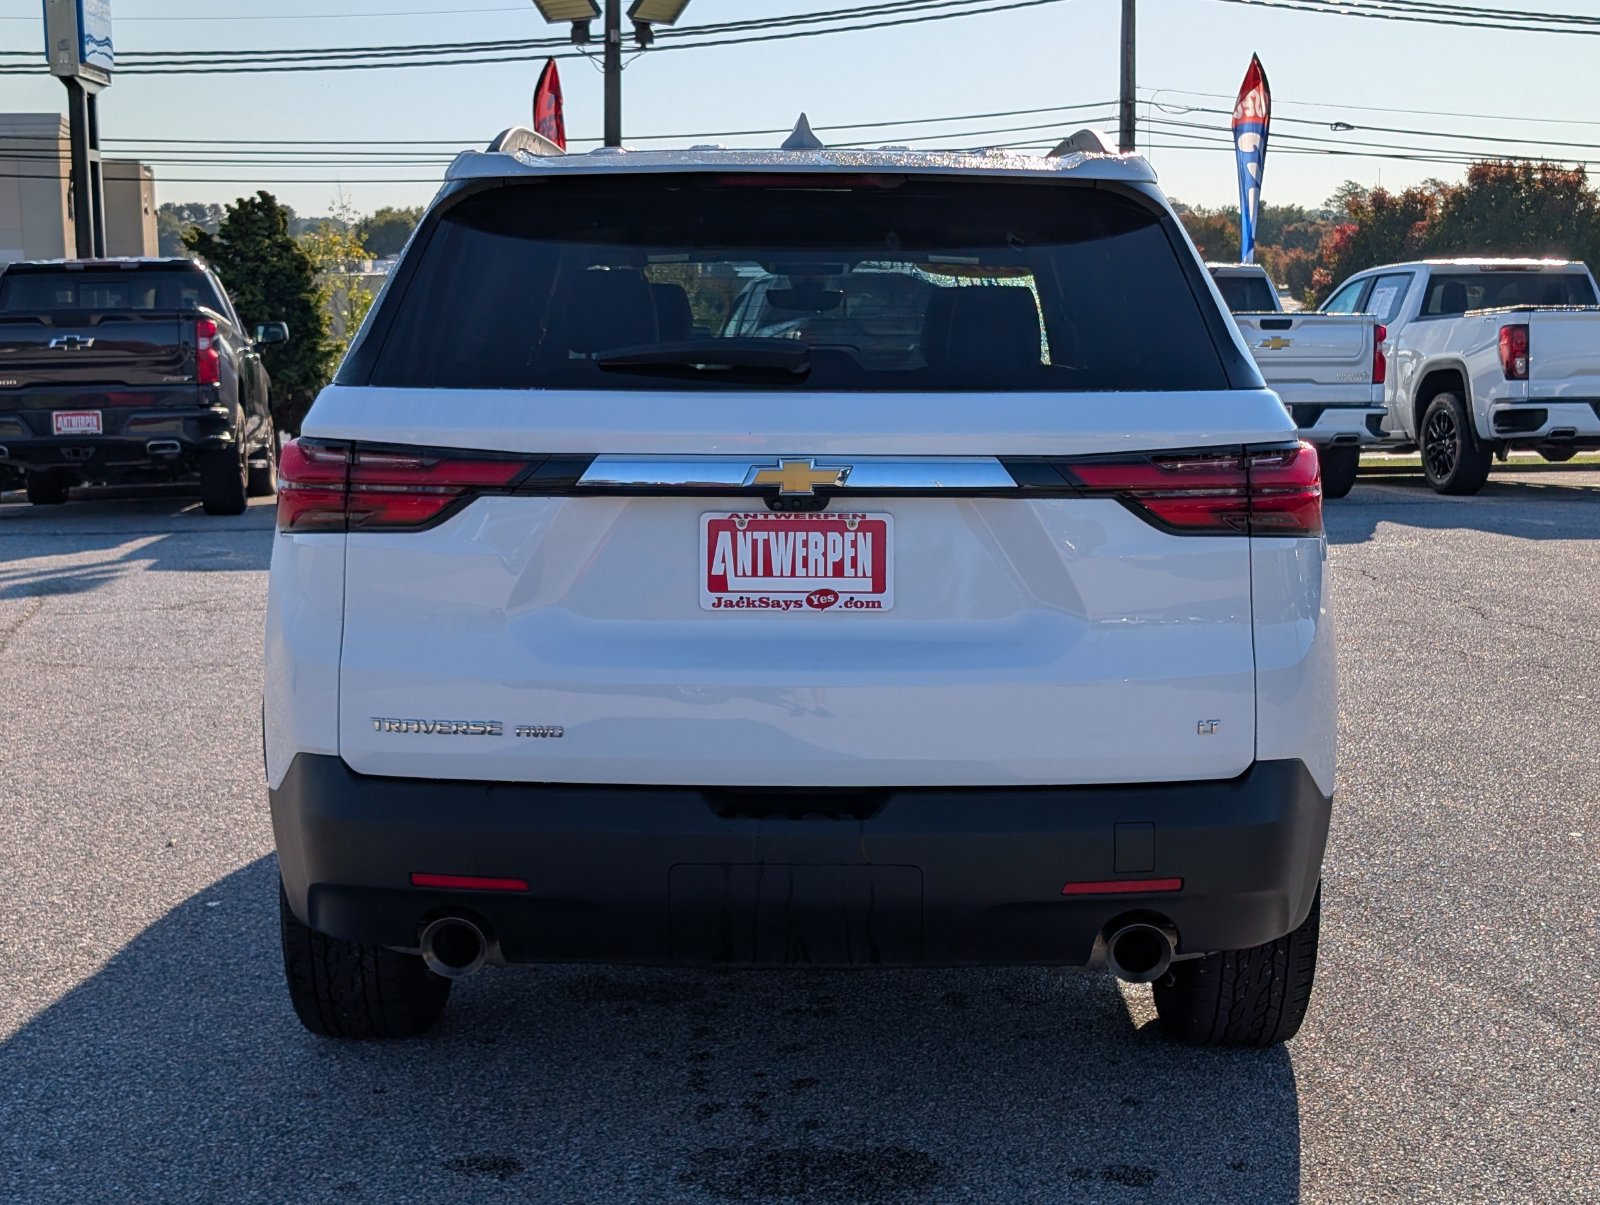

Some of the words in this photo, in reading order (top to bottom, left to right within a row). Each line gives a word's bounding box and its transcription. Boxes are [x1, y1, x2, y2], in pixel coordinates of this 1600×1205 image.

[711, 531, 873, 579] ANTWERPEN
[711, 596, 803, 611] JackSays
[808, 594, 835, 605] Yes
[370, 717, 504, 736] TRAVERSE
[515, 725, 564, 738] AWD
[1197, 719, 1221, 735] LT
